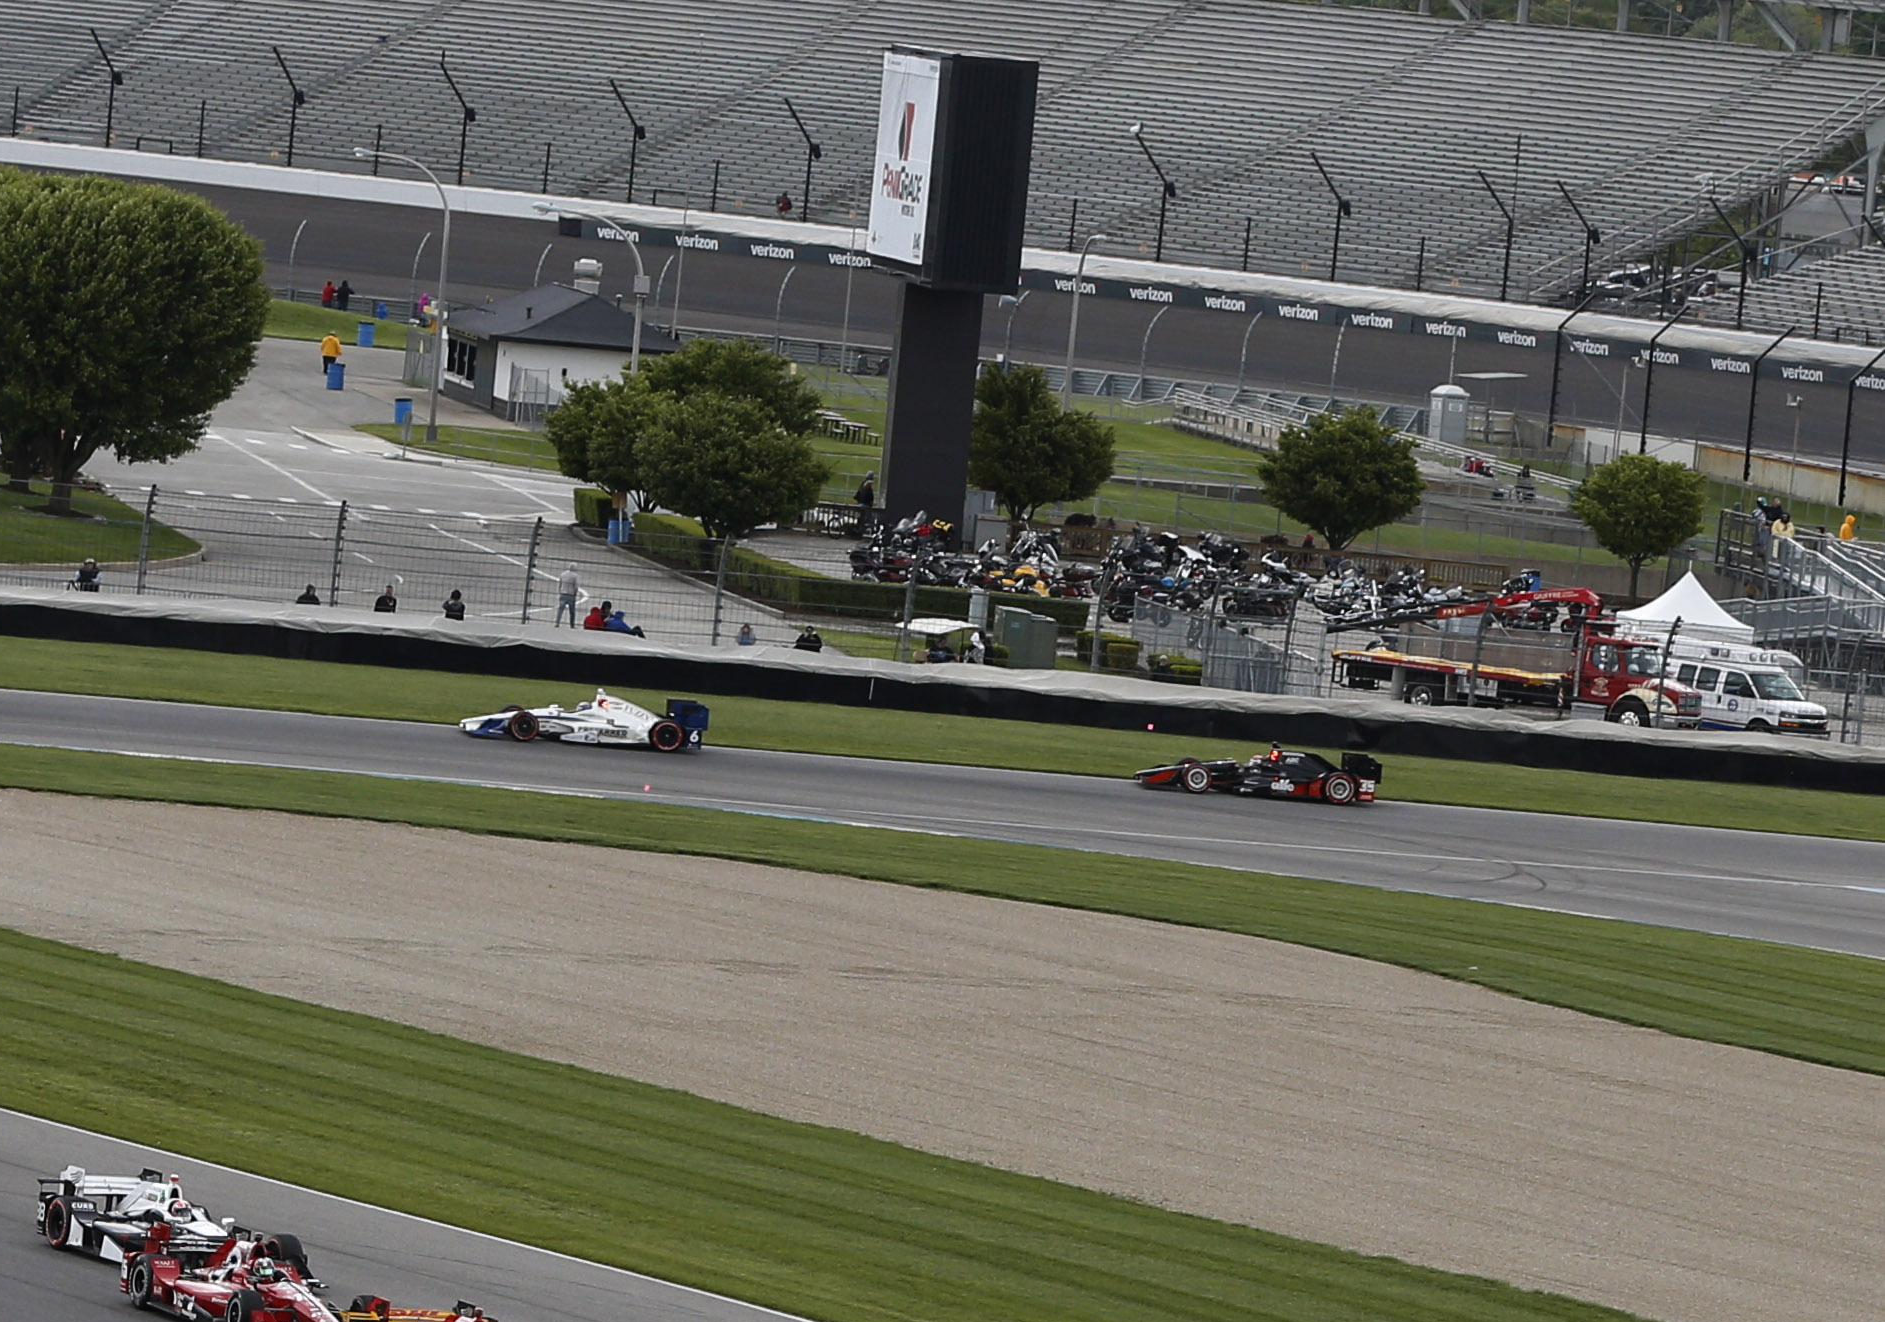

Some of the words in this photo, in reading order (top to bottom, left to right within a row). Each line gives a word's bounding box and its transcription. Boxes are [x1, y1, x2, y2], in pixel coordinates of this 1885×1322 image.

[675, 234, 718, 251] verizon
[750, 243, 794, 259] verizon
[828, 251, 871, 267] verizon
[1055, 277, 1097, 295] verion
[1129, 286, 1173, 302] verizon
[1204, 295, 1246, 311] verizon
[1278, 304, 1319, 320] verizon
[1351, 312, 1393, 328] verizon
[1497, 331, 1537, 347] verizon
[1710, 357, 1750, 373] verizon
[1781, 366, 1823, 382] verizon
[1855, 373, 1885, 390] verizo
[689, 730, 699, 743] 6
[1358, 779, 1376, 793] 35
